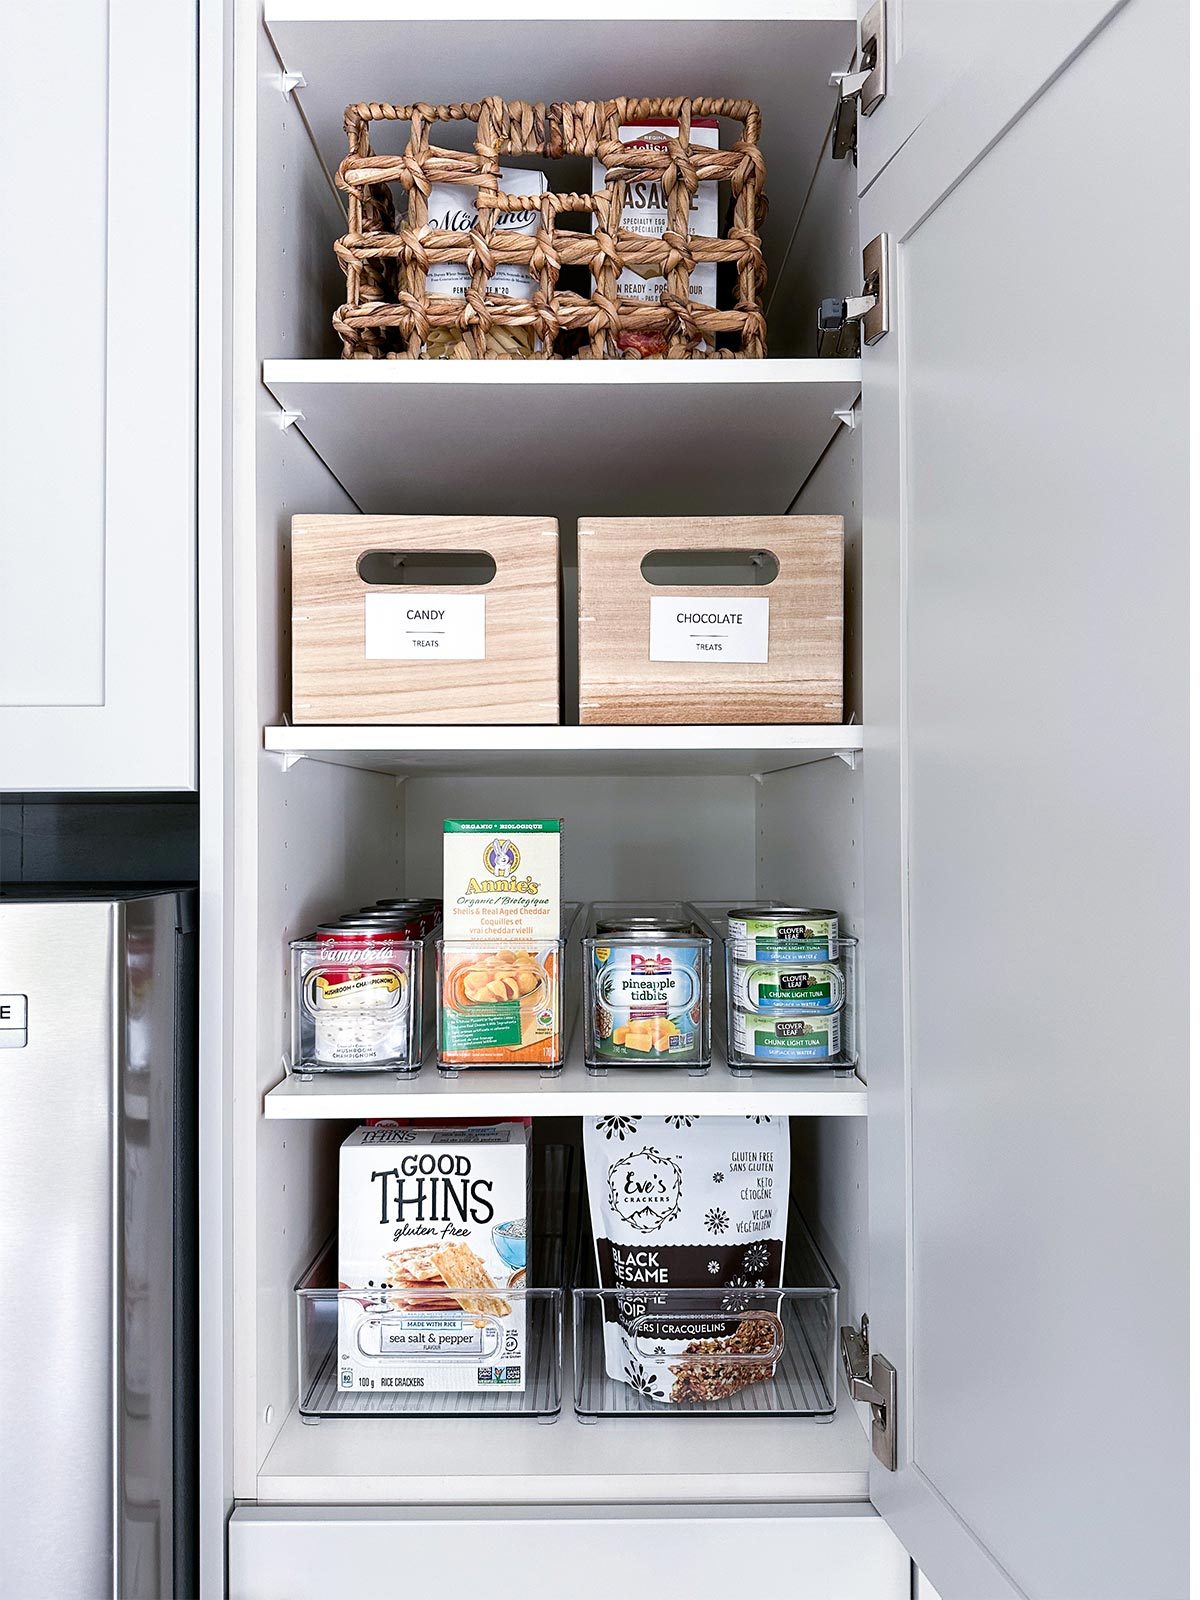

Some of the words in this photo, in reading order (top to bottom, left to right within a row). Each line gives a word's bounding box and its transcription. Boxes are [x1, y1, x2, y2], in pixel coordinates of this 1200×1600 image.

[624, 284, 646, 294] READY
[406, 610, 445, 621] CANDY
[676, 613, 743, 625] CHOCOLATE
[412, 639, 439, 648] TREATS
[696, 643, 723, 651] TREATS
[465, 875, 539, 895] Annie's
[499, 908, 518, 916] Aged
[484, 926, 515, 934] cheddar
[778, 927, 804, 935] CLOVER
[630, 953, 672, 970] Dole
[622, 978, 676, 990] pineapple
[781, 975, 807, 983] CLOVER
[324, 986, 351, 996] MUSHROOM
[631, 991, 668, 1001] tidbits
[777, 1022, 803, 1030] CLOVER
[764, 1038, 786, 1046] CHUNK
[804, 1038, 820, 1046] TUNA
[731, 1152, 757, 1162] GLUTEN
[759, 1152, 774, 1161] FREE
[401, 1153, 472, 1177] GOOD
[729, 1163, 747, 1173] SANS
[748, 1163, 774, 1172] GLUTEN
[623, 1170, 667, 1194] Eve's
[756, 1177, 773, 1188] KETO
[371, 1168, 495, 1225] THINS
[752, 1209, 773, 1221] VEGAN
[393, 1223, 438, 1242] gluten
[440, 1222, 472, 1239] free
[735, 1220, 771, 1234] VÉGÉTALIEN
[612, 1247, 660, 1267] BLACK
[614, 1262, 669, 1283] SESAME
[661, 1322, 726, 1335] CRACQUELINS
[389, 1335, 406, 1344] sea
[408, 1332, 426, 1344] salt
[428, 1333, 437, 1344] &
[438, 1334, 474, 1345] pepper
[358, 1377, 370, 1387] 100
[380, 1377, 394, 1387] RICE
[394, 1377, 425, 1387] CRACKERS
